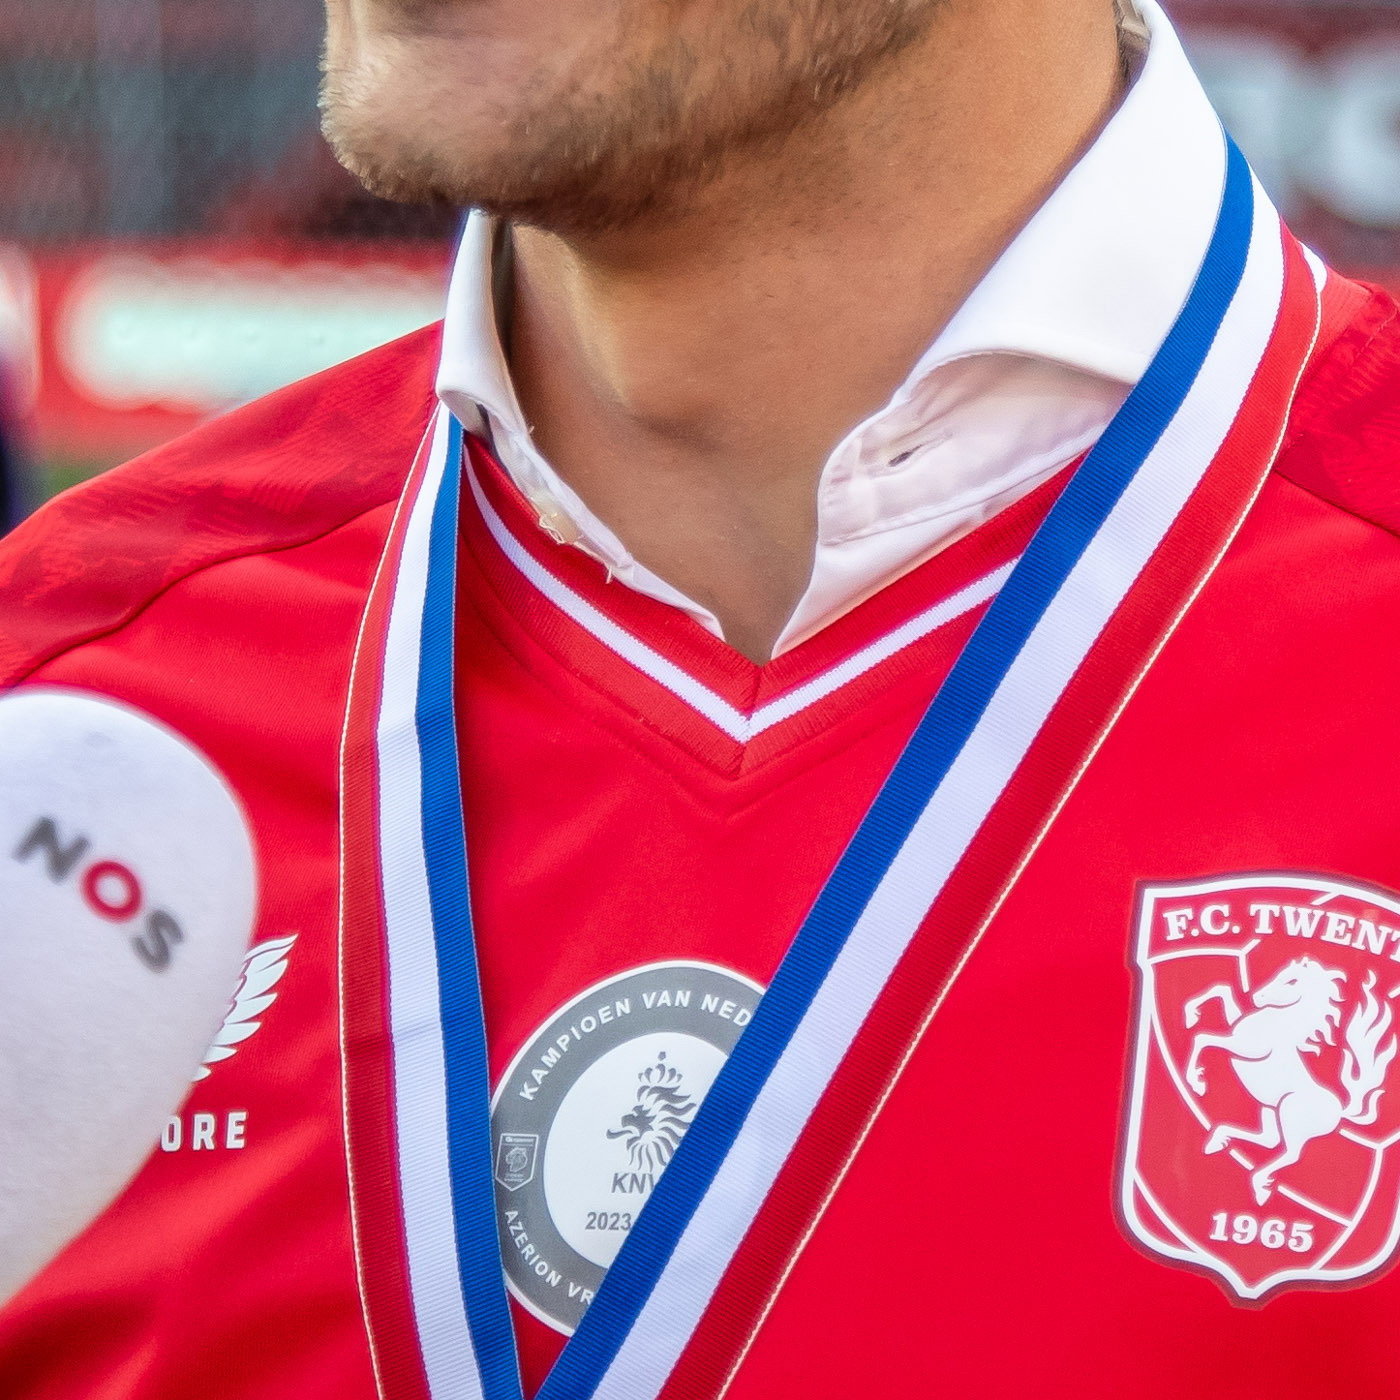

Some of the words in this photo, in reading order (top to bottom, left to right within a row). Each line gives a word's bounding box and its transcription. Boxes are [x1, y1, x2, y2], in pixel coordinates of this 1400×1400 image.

[10, 815, 186, 975] NOS
[1162, 904, 1241, 941] F.C.
[519, 998, 632, 1101] KAMPIOEN
[642, 989, 692, 1010] VAN
[700, 993, 751, 1027] NED
[504, 1209, 562, 1288] AZERION
[1209, 1212, 1314, 1253] 1965
